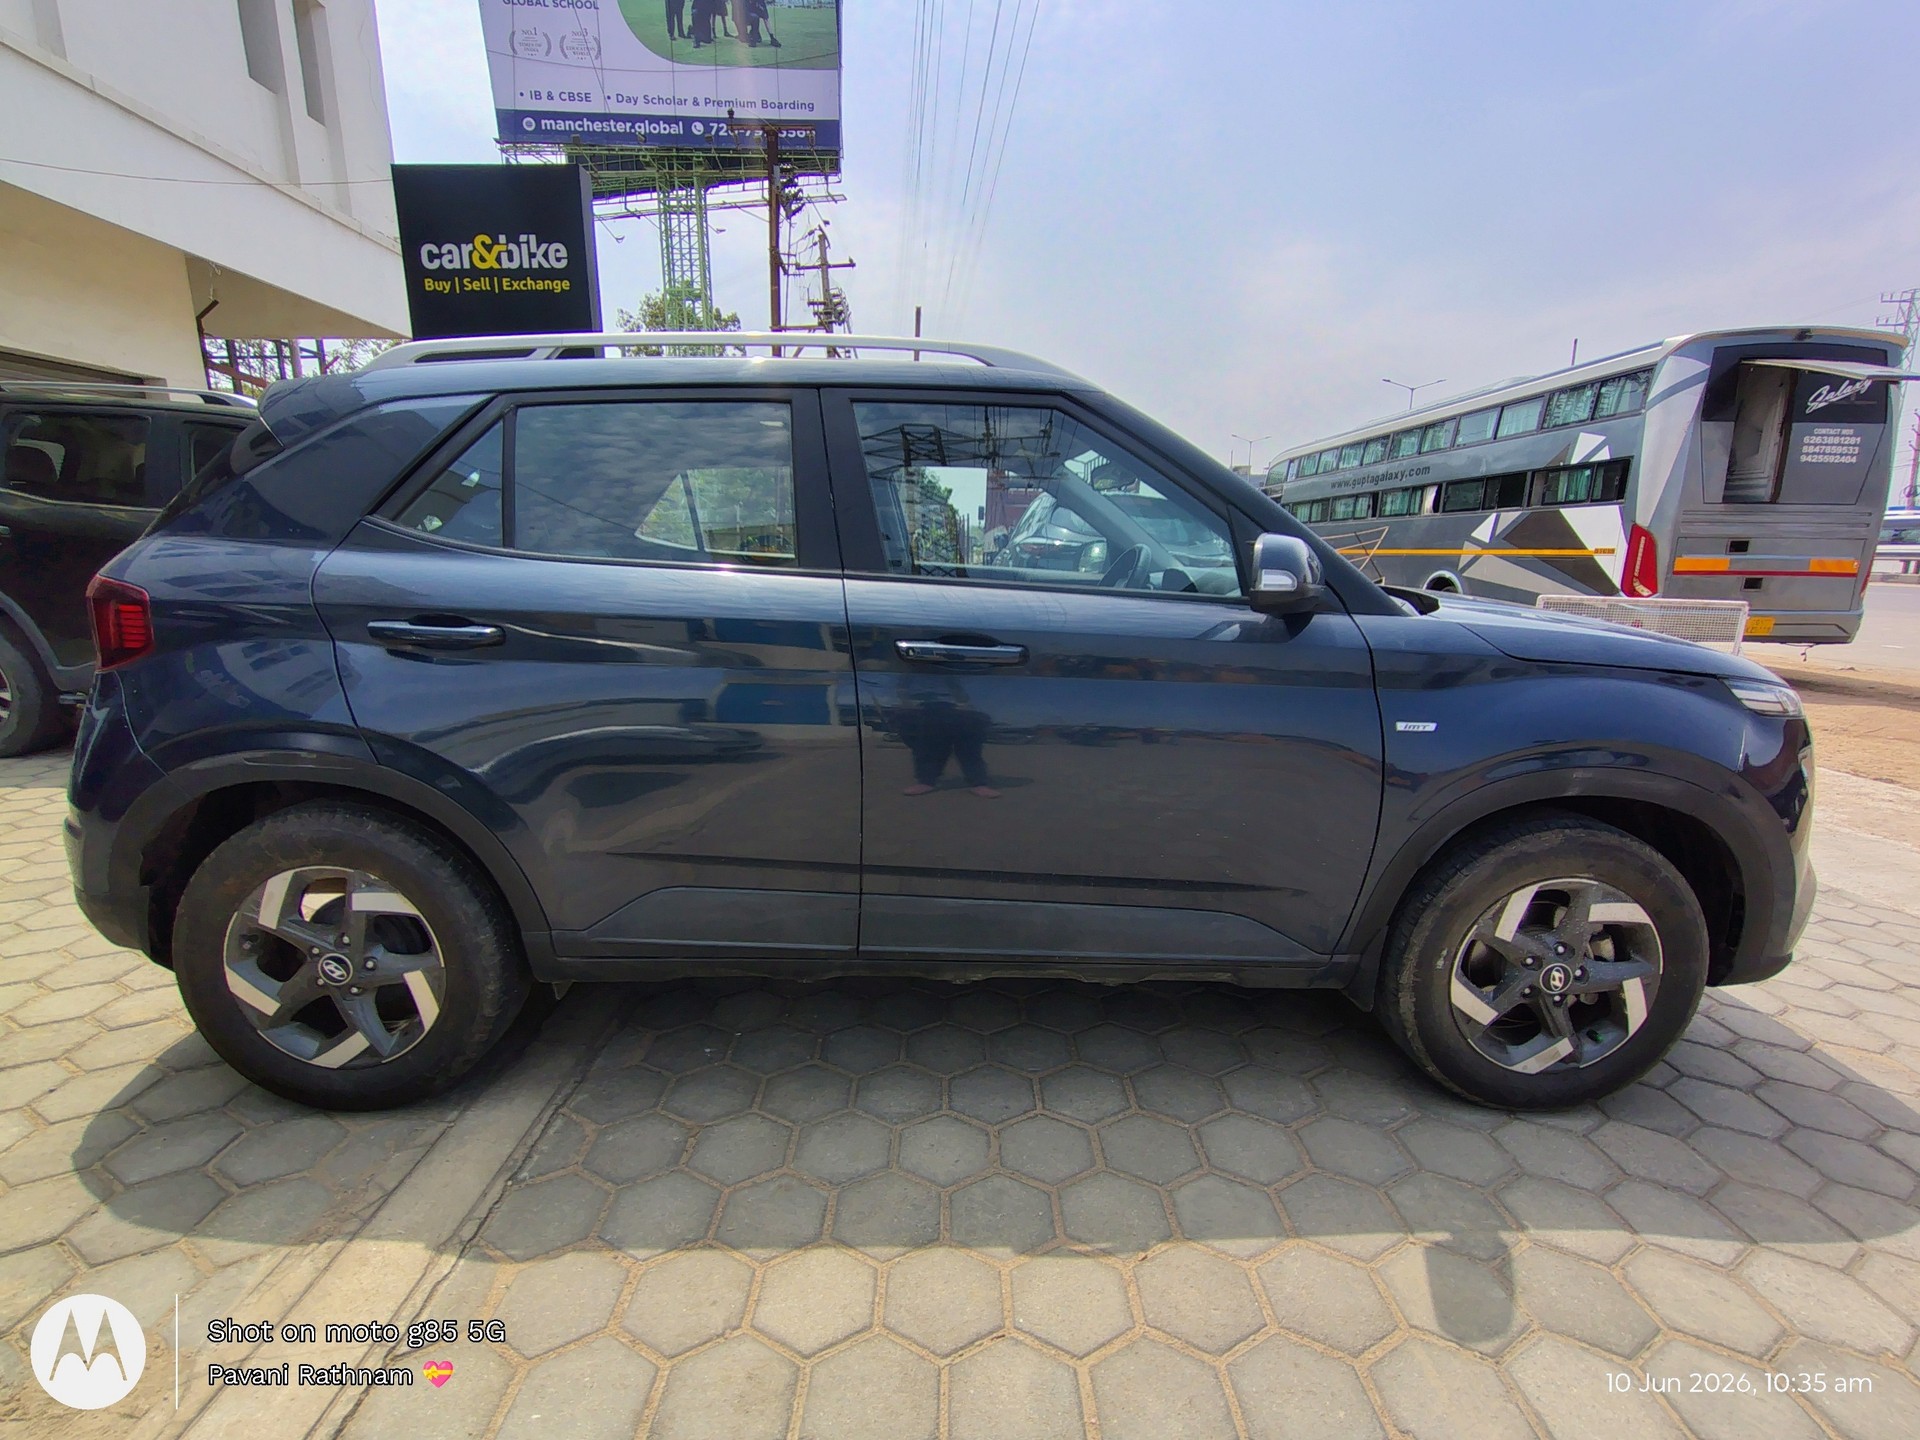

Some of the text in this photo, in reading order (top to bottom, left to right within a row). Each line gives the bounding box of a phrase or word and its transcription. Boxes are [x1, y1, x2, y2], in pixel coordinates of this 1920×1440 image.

[552, 0, 600, 10] SCHOOL
[529, 90, 592, 102] IB & CBSE
[615, 93, 815, 112] Day Scholar & Premium Boarding
[541, 117, 684, 135] manchester.global
[420, 234, 569, 270] car&bike
[424, 278, 451, 294] Buy
[463, 276, 491, 291] Sell
[502, 276, 571, 293] Exchange
[1330, 466, 1431, 489] www.guptagalaxy.com
